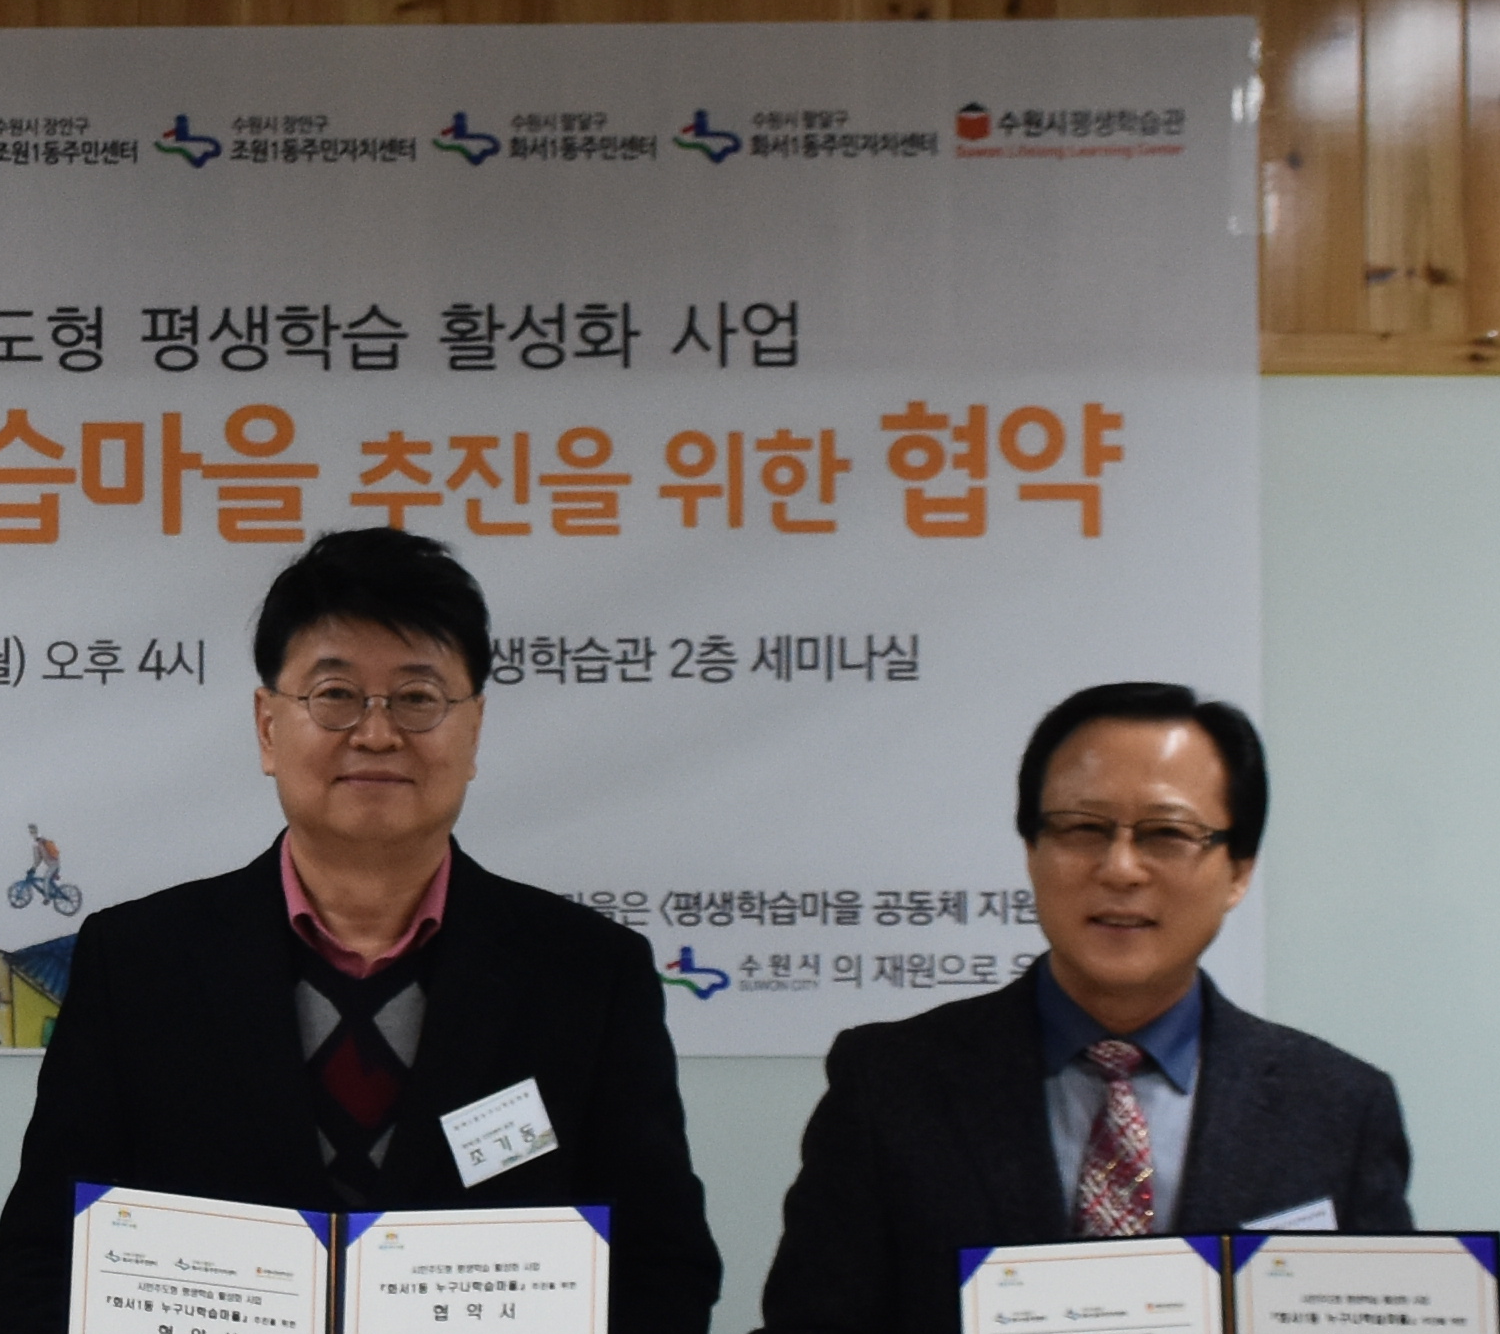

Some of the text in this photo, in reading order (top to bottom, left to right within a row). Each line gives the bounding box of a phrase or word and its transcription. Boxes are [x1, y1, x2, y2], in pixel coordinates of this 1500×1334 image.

[231, 115, 278, 135] 수원시
[230, 137, 416, 163] 조원1동주민자치센터
[509, 133, 657, 161] 화서1동주민센터
[751, 131, 938, 158] 화서1동주민자치센터
[141, 302, 408, 372] 평생학습
[440, 301, 640, 371] 활성화
[672, 300, 799, 368] 사업
[350, 427, 631, 535] 추진을
[659, 427, 851, 533] 위한
[880, 400, 1124, 537] 협약
[43, 639, 124, 685] 오후
[138, 637, 206, 685] 4시
[489, 634, 920, 685] 생학습관 2층 세미나실
[873, 890, 968, 926] 공동체
[834, 954, 862, 989] 의
[873, 954, 999, 989] 재원으로
